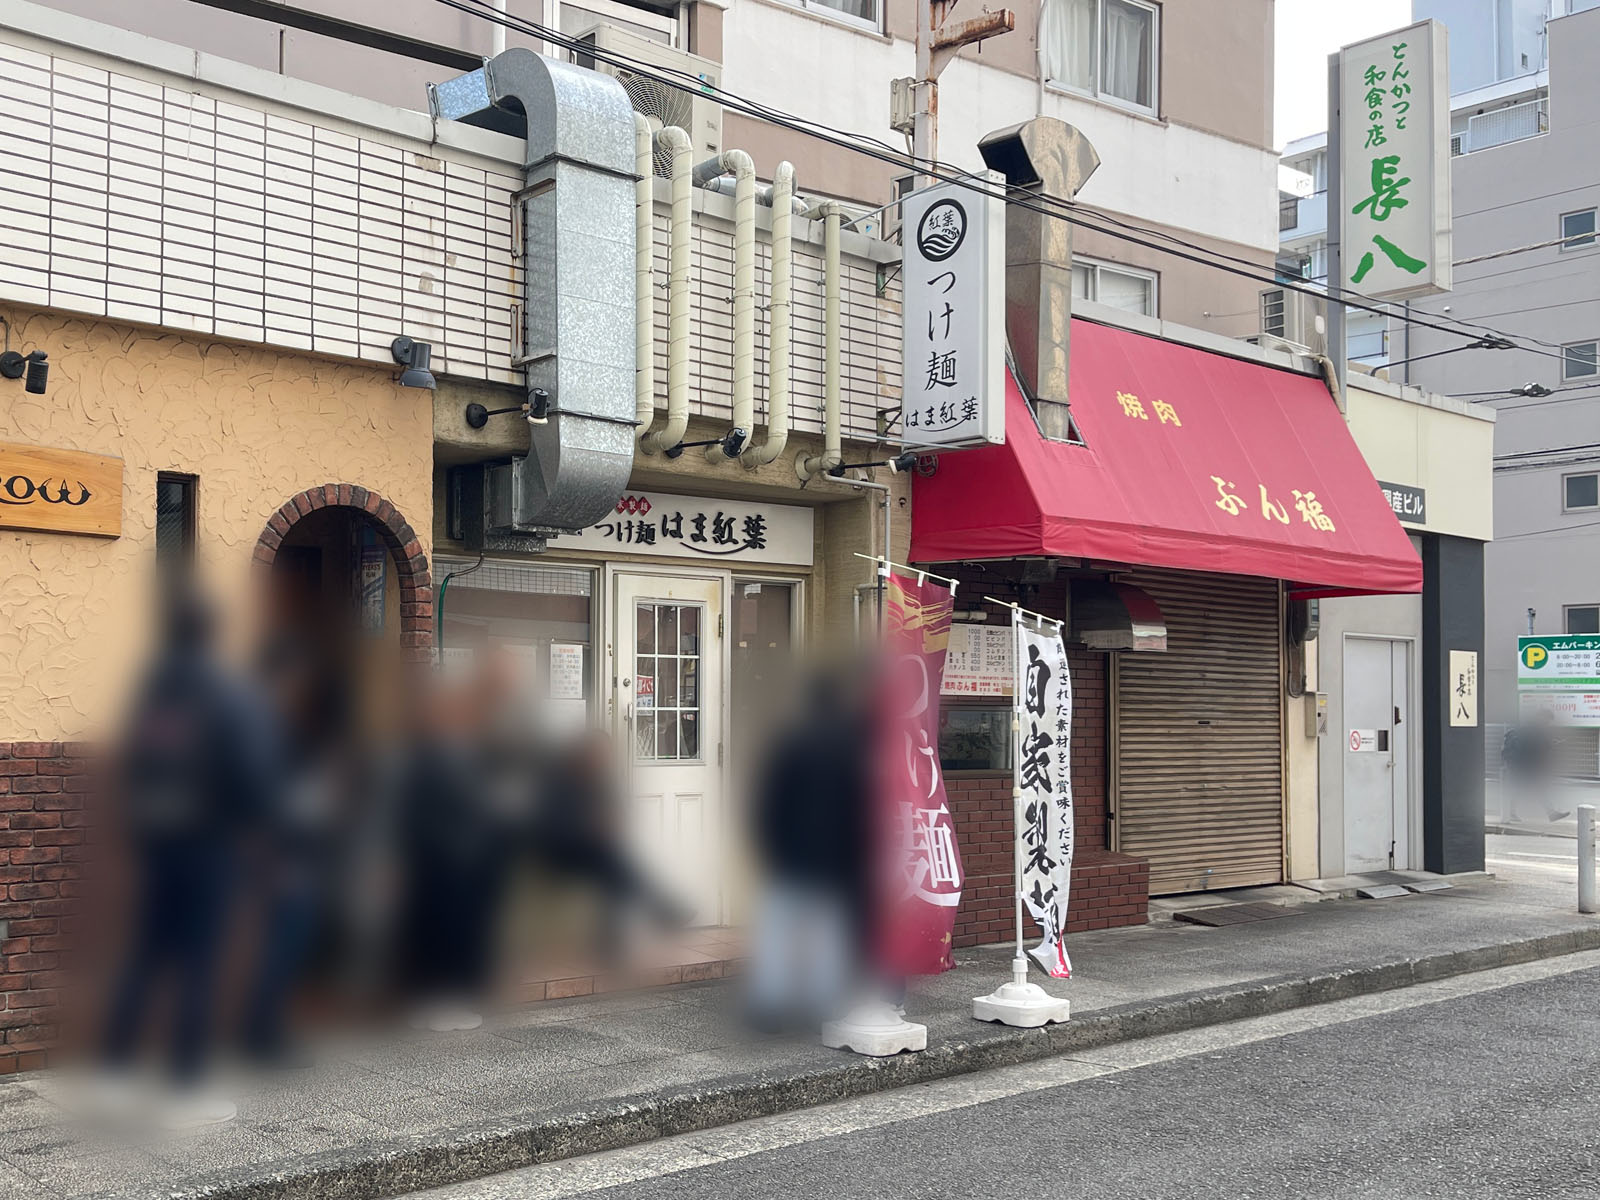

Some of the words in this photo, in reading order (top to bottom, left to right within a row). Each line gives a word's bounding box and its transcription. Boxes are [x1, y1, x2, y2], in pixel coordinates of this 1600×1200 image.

[1364, 65, 1387, 148] 和食の店
[1390, 43, 1411, 129] とんかつと
[928, 210, 954, 231] 紅葉
[1350, 155, 1427, 283] 長八
[925, 271, 958, 391] つけ麺
[905, 396, 979, 428] はま紅葉
[1116, 391, 1182, 427] 焼肉
[594, 520, 656, 545] つけ麺
[661, 511, 768, 550] はま紅葉
[1210, 475, 1336, 532] ぶん福
